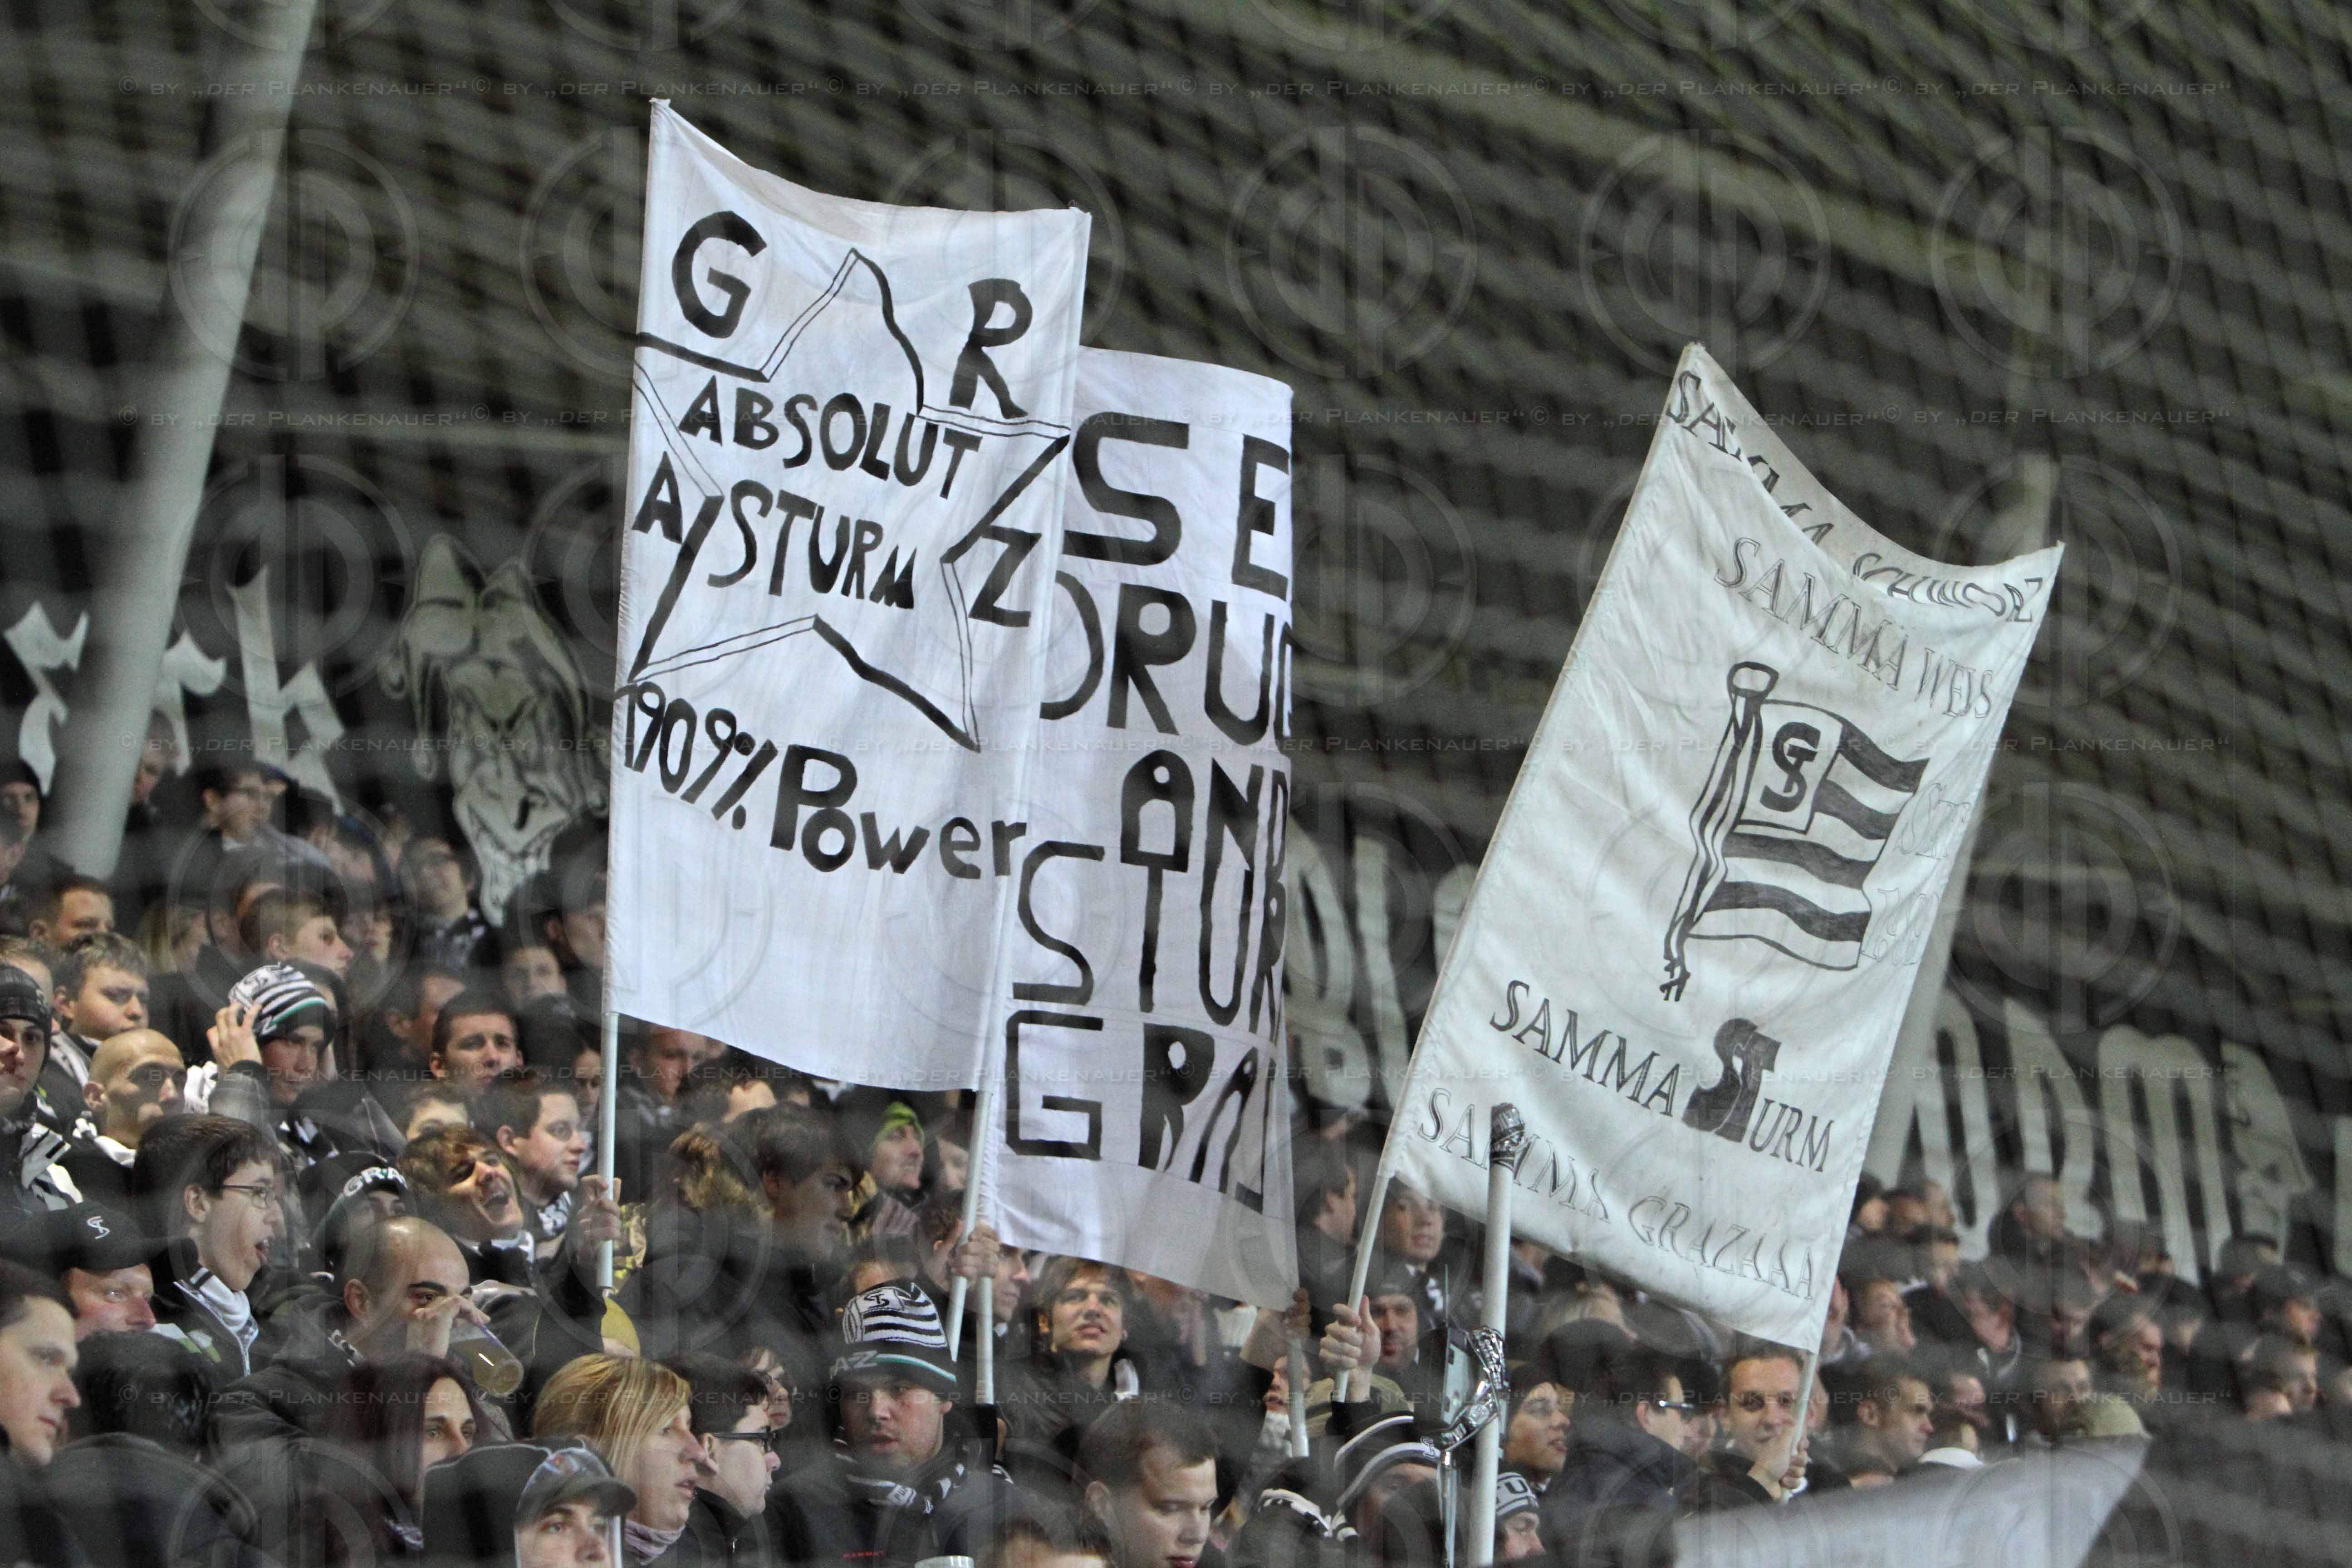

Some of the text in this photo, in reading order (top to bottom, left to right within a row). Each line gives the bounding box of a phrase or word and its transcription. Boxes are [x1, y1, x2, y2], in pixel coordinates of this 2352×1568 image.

[671, 210, 1033, 420] G R
[679, 374, 983, 499] ABSOLUT
[632, 451, 683, 544] A
[707, 479, 916, 610] STURM
[1713, 537, 1908, 691] SAMMA
[769, 744, 1028, 879] Power
[1489, 979, 1681, 1117] SAMMA
